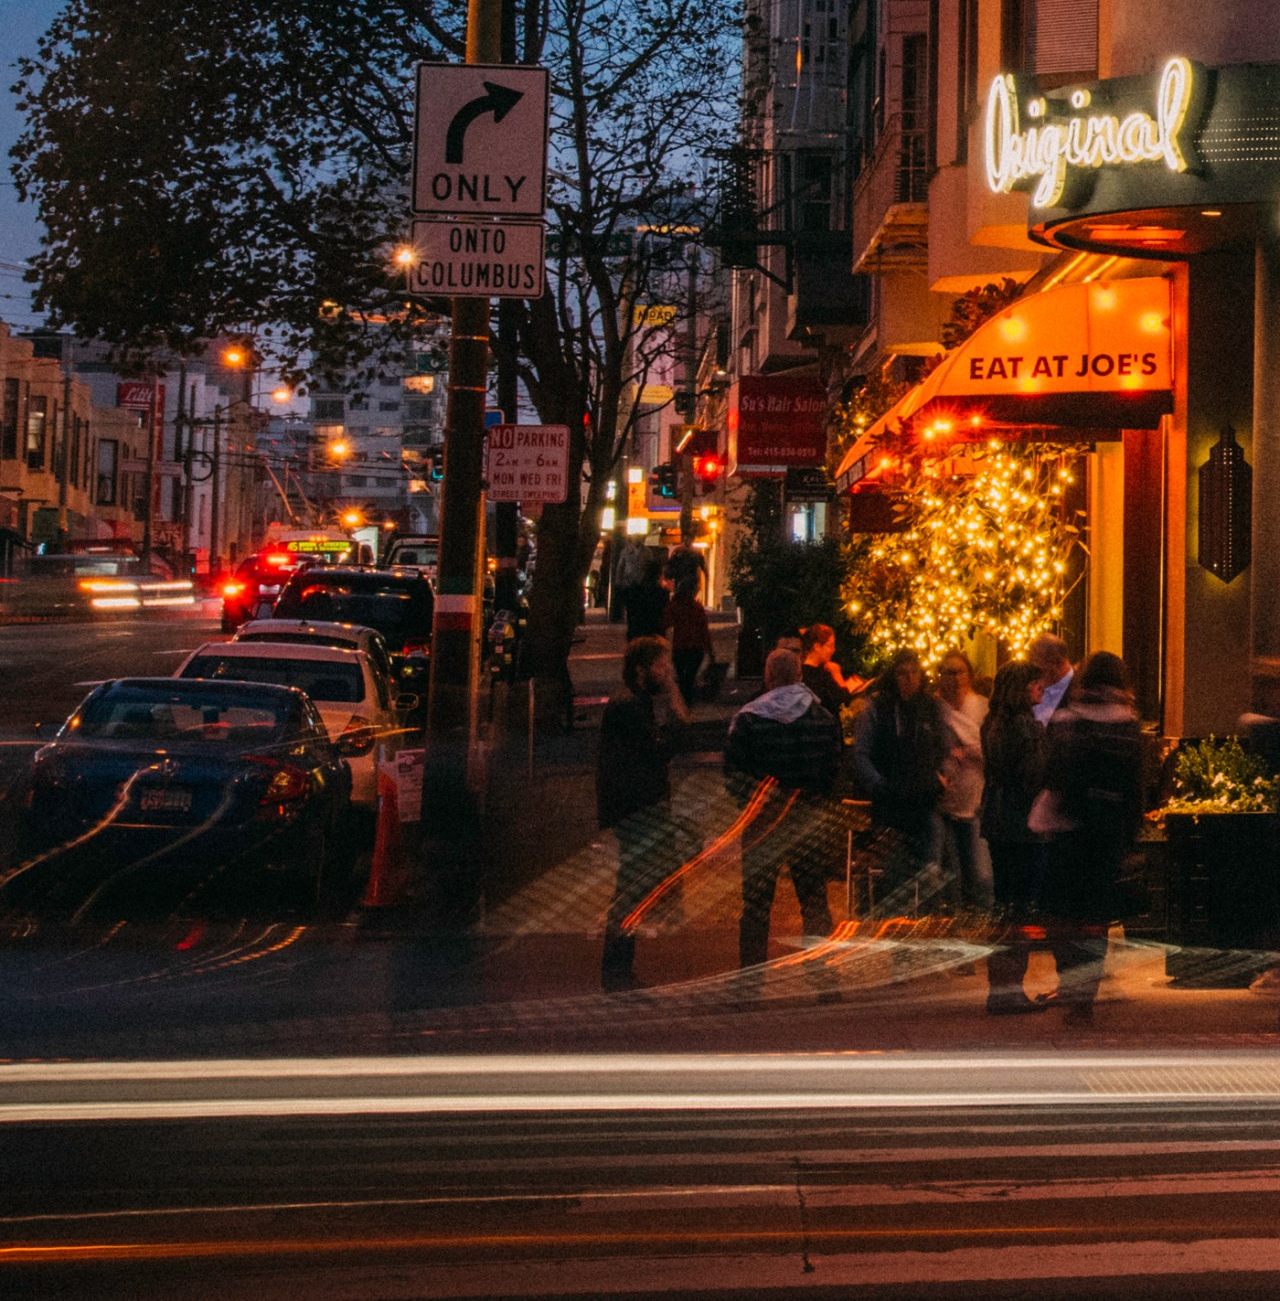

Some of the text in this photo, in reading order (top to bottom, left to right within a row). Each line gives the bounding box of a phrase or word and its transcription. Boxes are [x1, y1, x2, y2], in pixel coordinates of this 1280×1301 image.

[985, 56, 1192, 209] Original
[432, 173, 526, 202] ONLY
[450, 227, 506, 254] ONTO
[417, 262, 535, 289] COLUMBUS
[968, 352, 1157, 380] EAT AT JOE'S
[767, 395, 792, 412] Hair
[490, 428, 564, 447] NO PARKING
[493, 473, 561, 486] MON WED FRI
